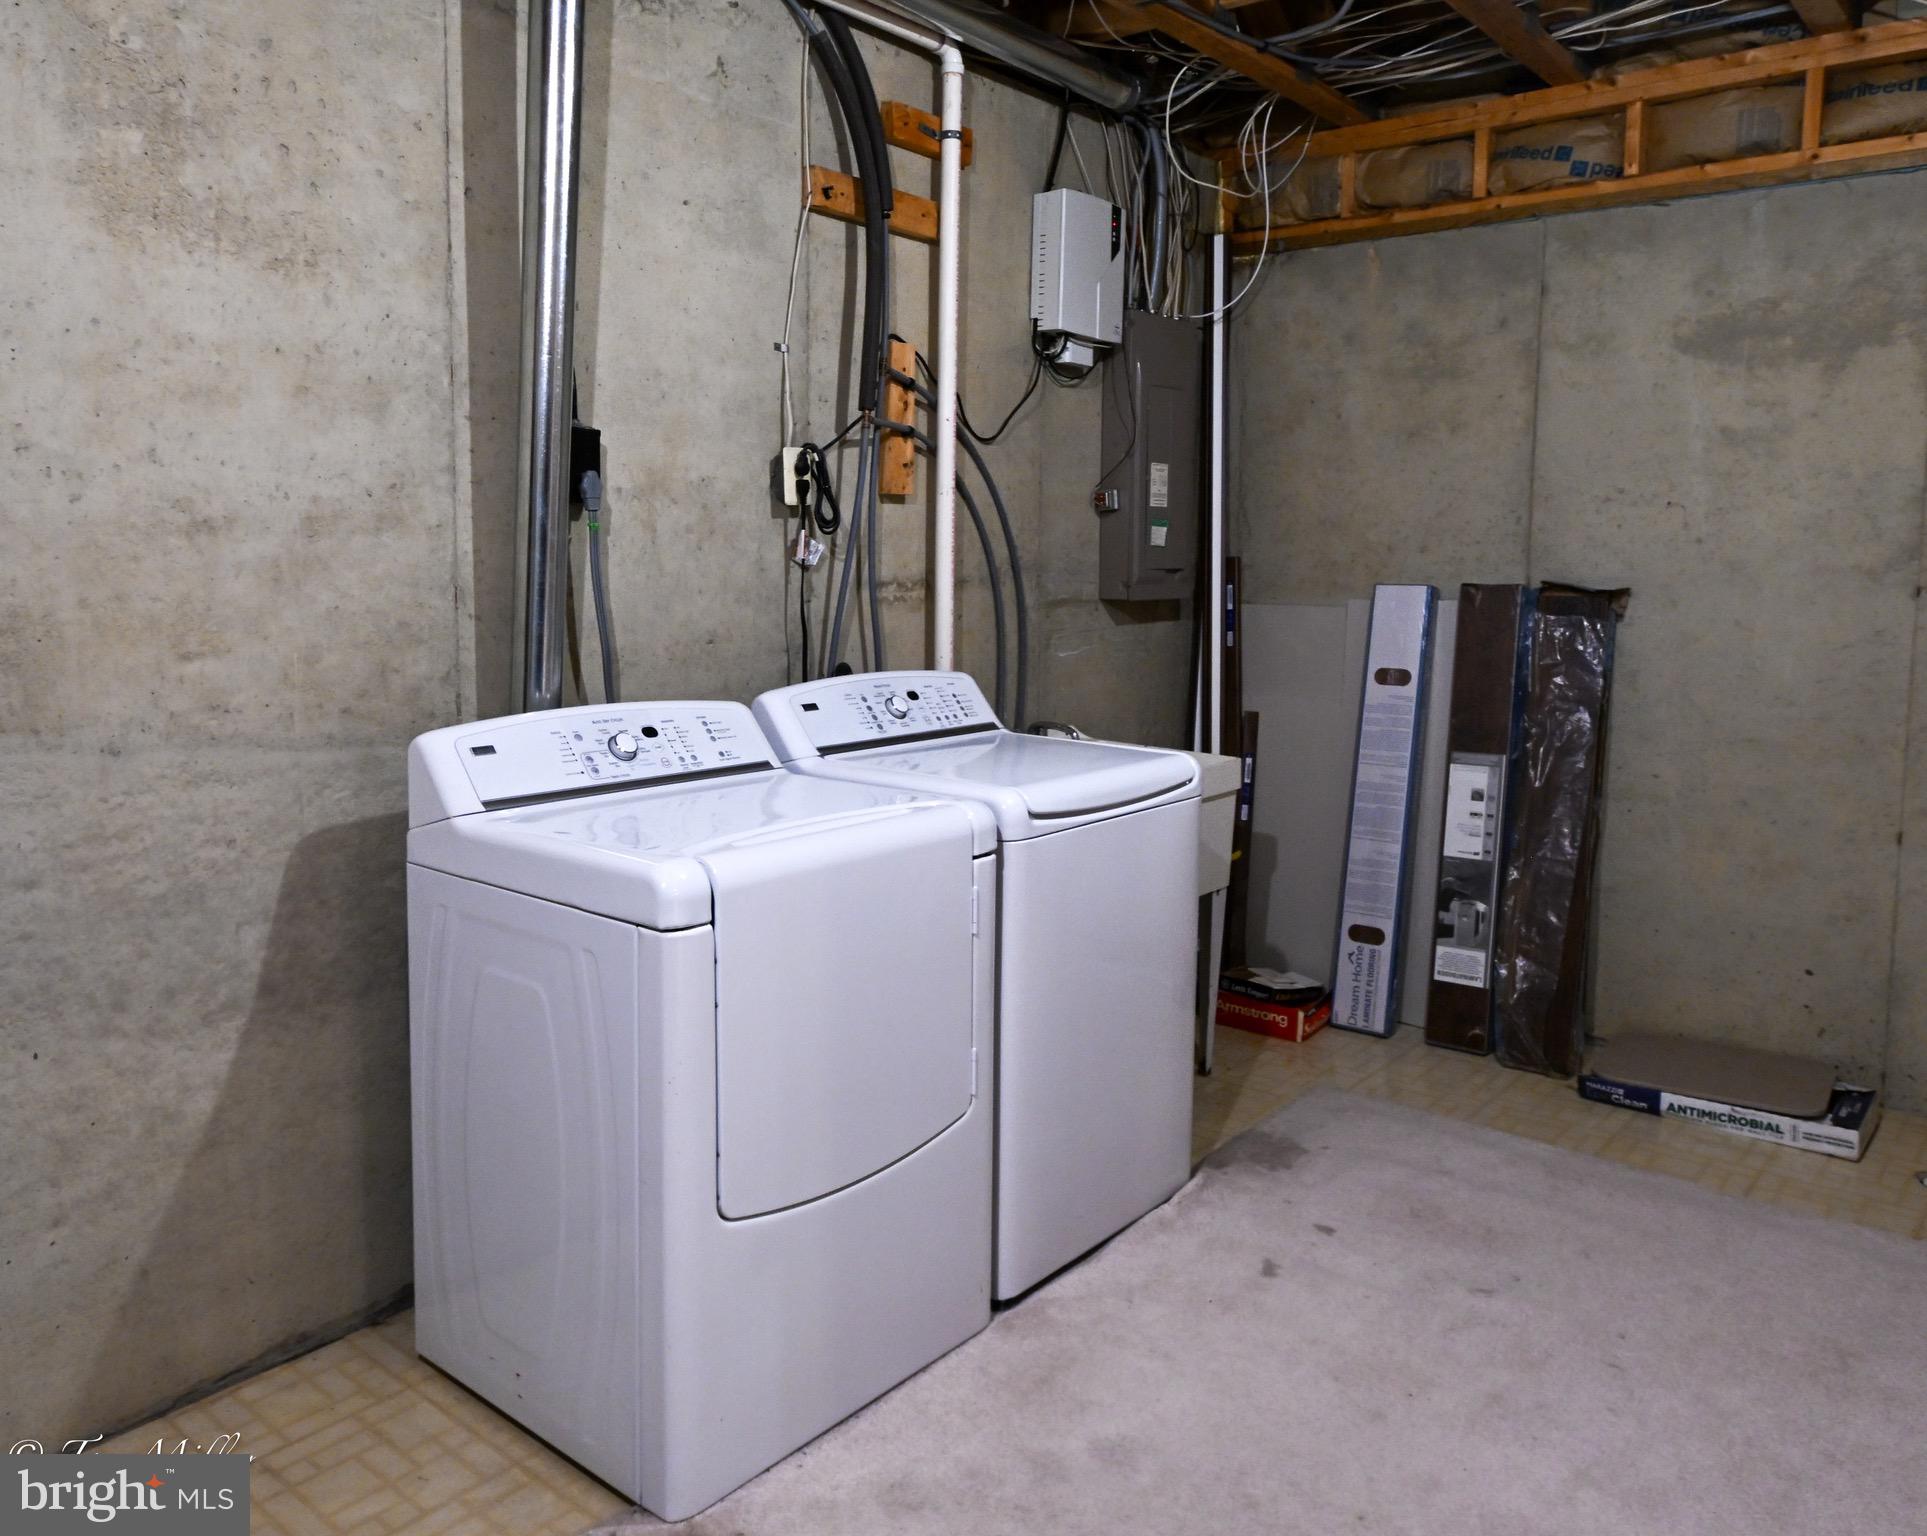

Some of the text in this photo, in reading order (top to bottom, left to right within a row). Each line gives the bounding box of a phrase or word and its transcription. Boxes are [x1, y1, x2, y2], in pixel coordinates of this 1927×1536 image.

[1347, 945, 1365, 1026] Dream Home
[1666, 1102, 1785, 1135] ANTIMICROBIAL
